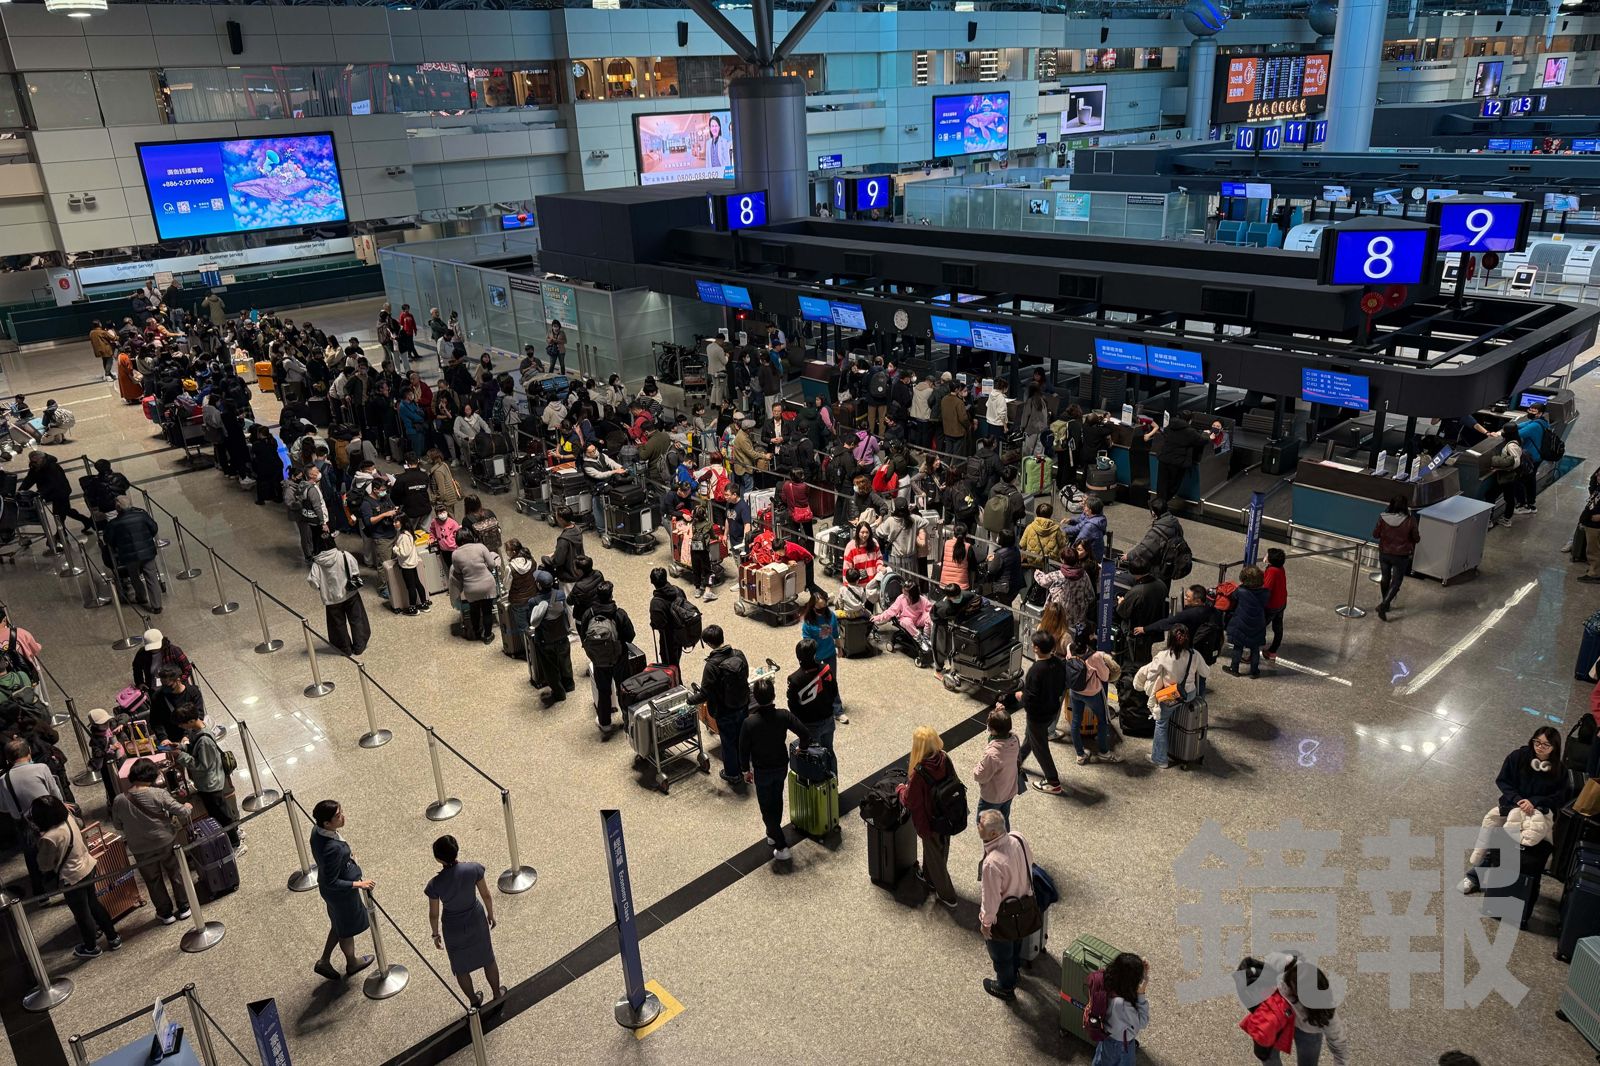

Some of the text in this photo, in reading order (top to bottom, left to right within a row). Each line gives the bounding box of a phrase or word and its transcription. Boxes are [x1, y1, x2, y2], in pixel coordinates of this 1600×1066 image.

[1487, 101, 1501, 115] 12
[1510, 100, 1518, 114] 12
[1518, 97, 1531, 111] 13
[1240, 129, 1253, 148] 10
[1266, 128, 1279, 147] 10
[1289, 123, 1303, 141] 11
[1316, 123, 1325, 141] 11
[836, 181, 842, 206] 9
[867, 180, 879, 206] 9
[740, 197, 754, 225] 8
[1465, 208, 1494, 246] 9
[1363, 236, 1394, 279] 8
[874, 321, 879, 329] 6
[926, 329, 931, 338] 5
[1024, 344, 1029, 352] 4
[1087, 354, 1093, 362] 3
[1216, 373, 1223, 382] 2
[1384, 399, 1389, 410] 1
[1101, 603, 1109, 627] Economy
[618, 869, 627, 903] Economy
